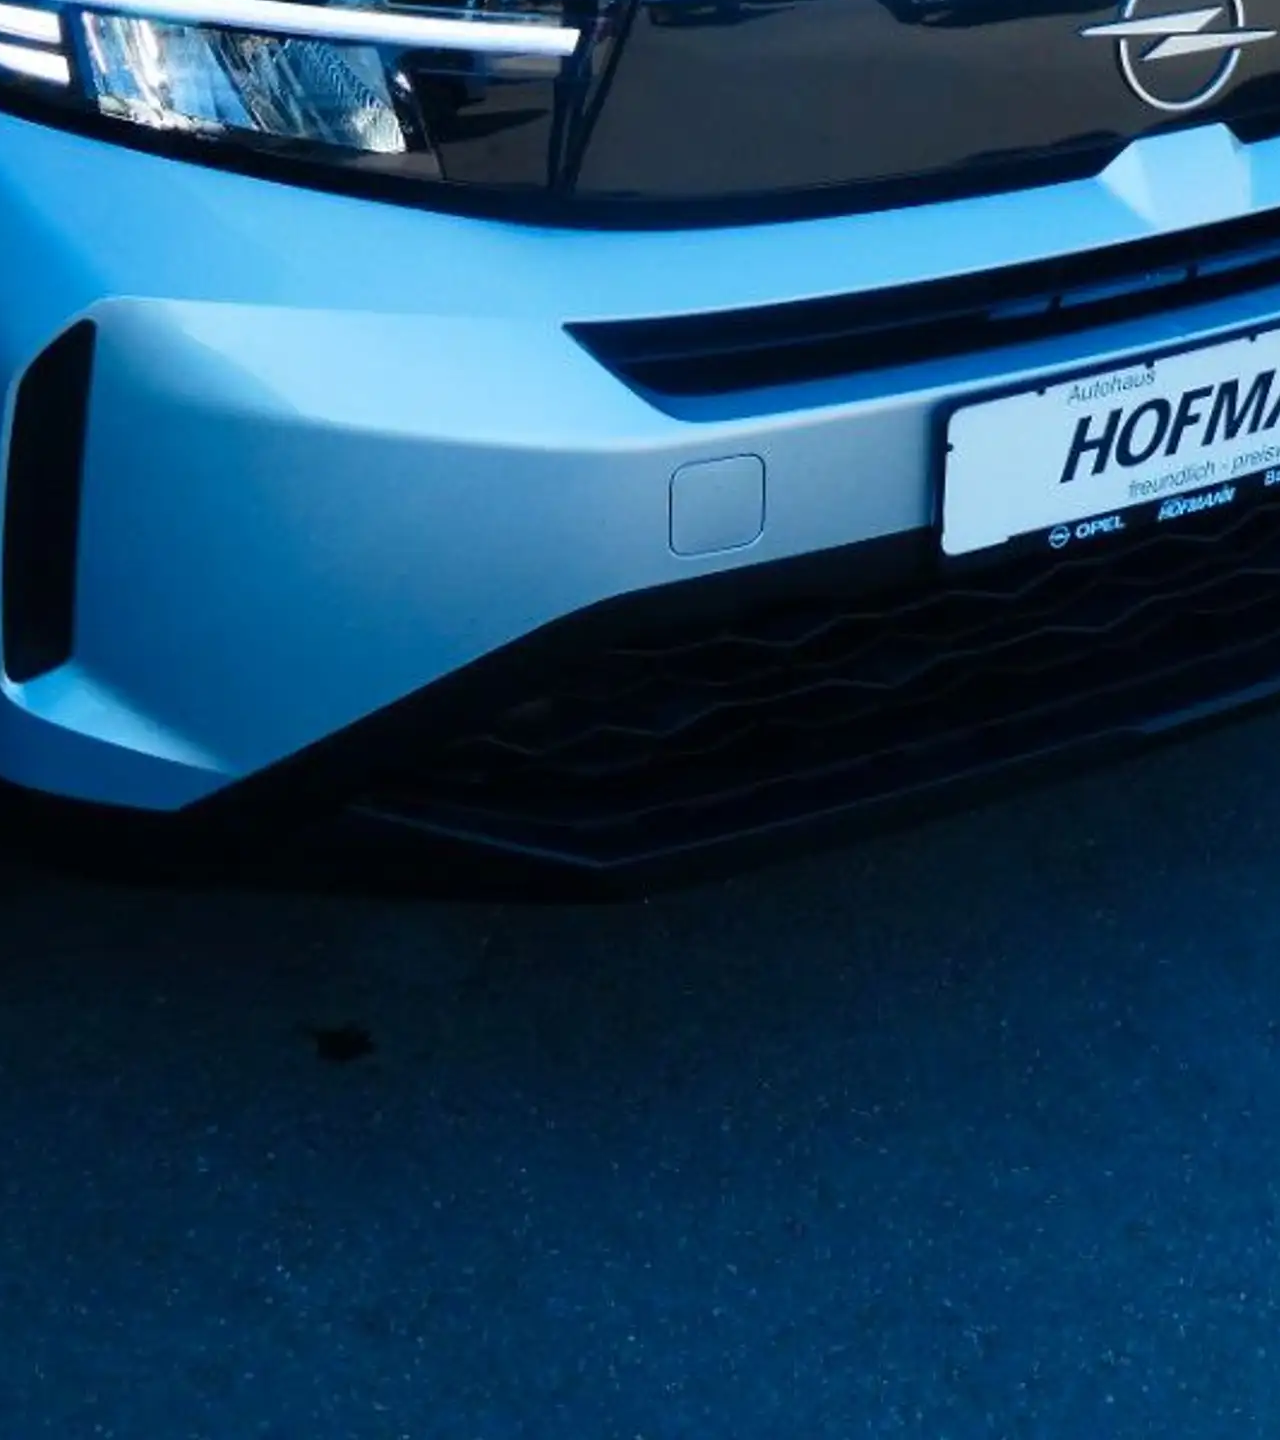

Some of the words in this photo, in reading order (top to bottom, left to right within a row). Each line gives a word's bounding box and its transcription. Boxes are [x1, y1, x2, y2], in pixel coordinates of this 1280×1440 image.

[1067, 368, 1156, 404] Autohaus
[1128, 461, 1216, 498] freundlich
[1075, 515, 1125, 539] OPEL
